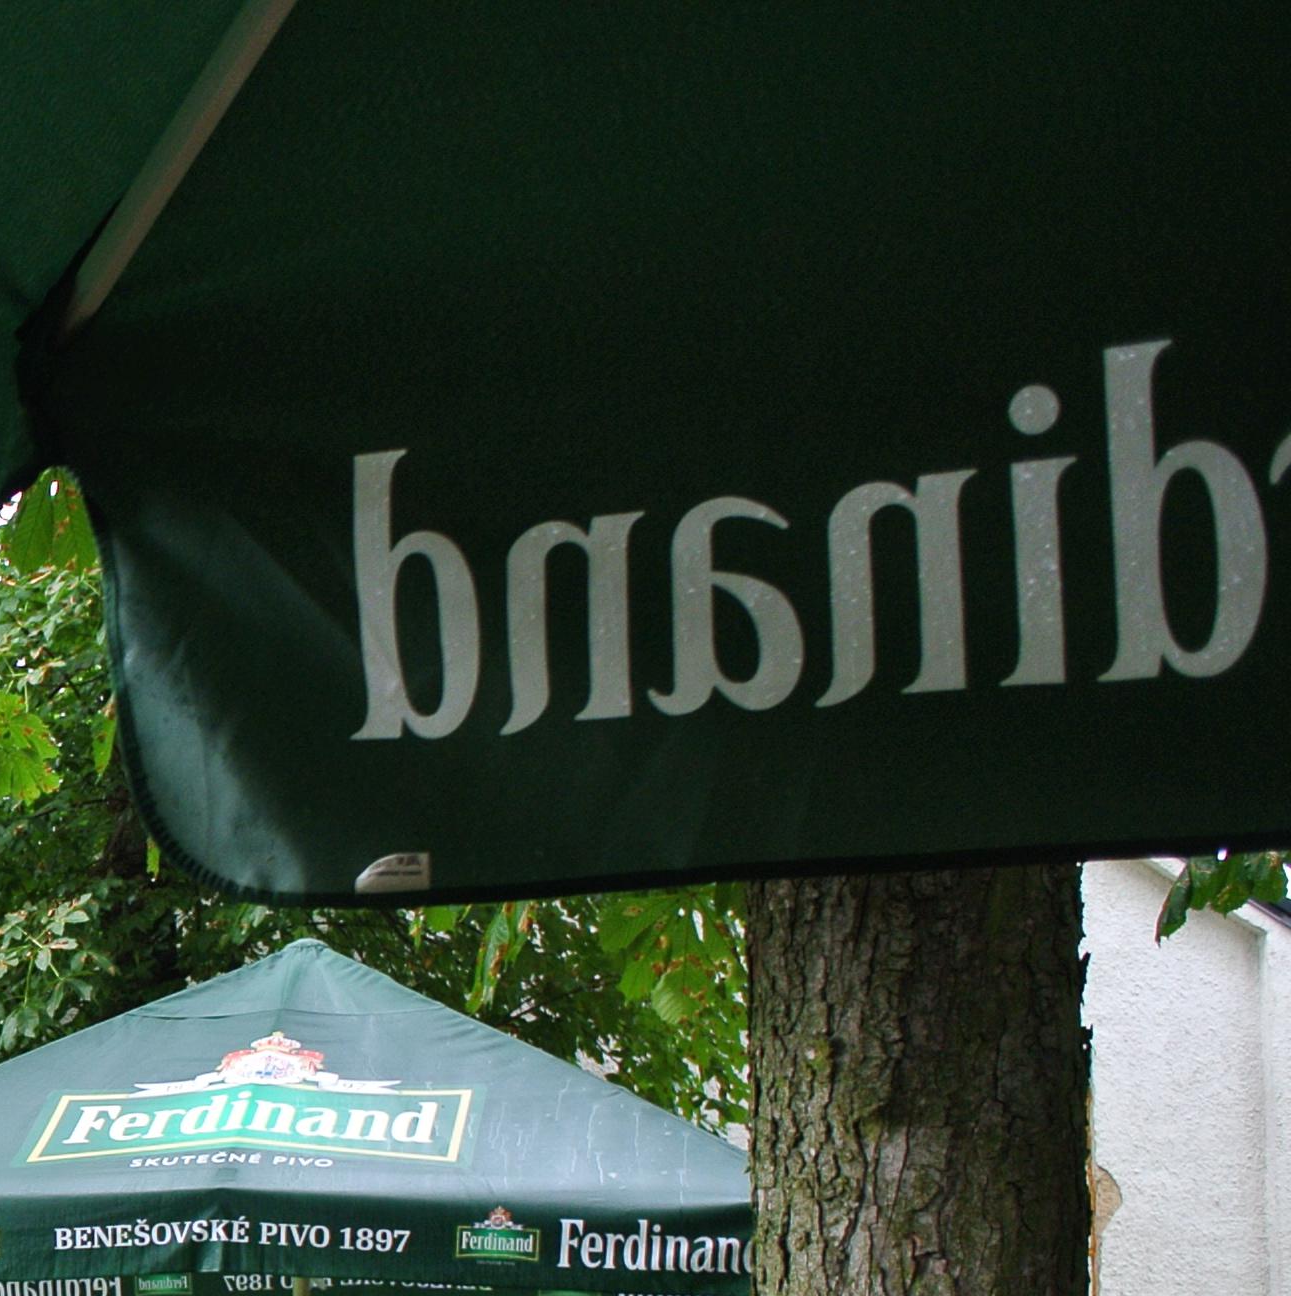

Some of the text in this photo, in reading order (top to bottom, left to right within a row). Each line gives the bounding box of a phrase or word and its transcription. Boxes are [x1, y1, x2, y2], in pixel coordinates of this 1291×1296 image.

[62, 1091, 437, 1144] Ferdinand
[130, 1150, 333, 1168] SKUTEČNÉ PIVO
[54, 1216, 412, 1253] BENEŠOVSKÉ PIVO 1897
[461, 1231, 534, 1253] Ferdinand
